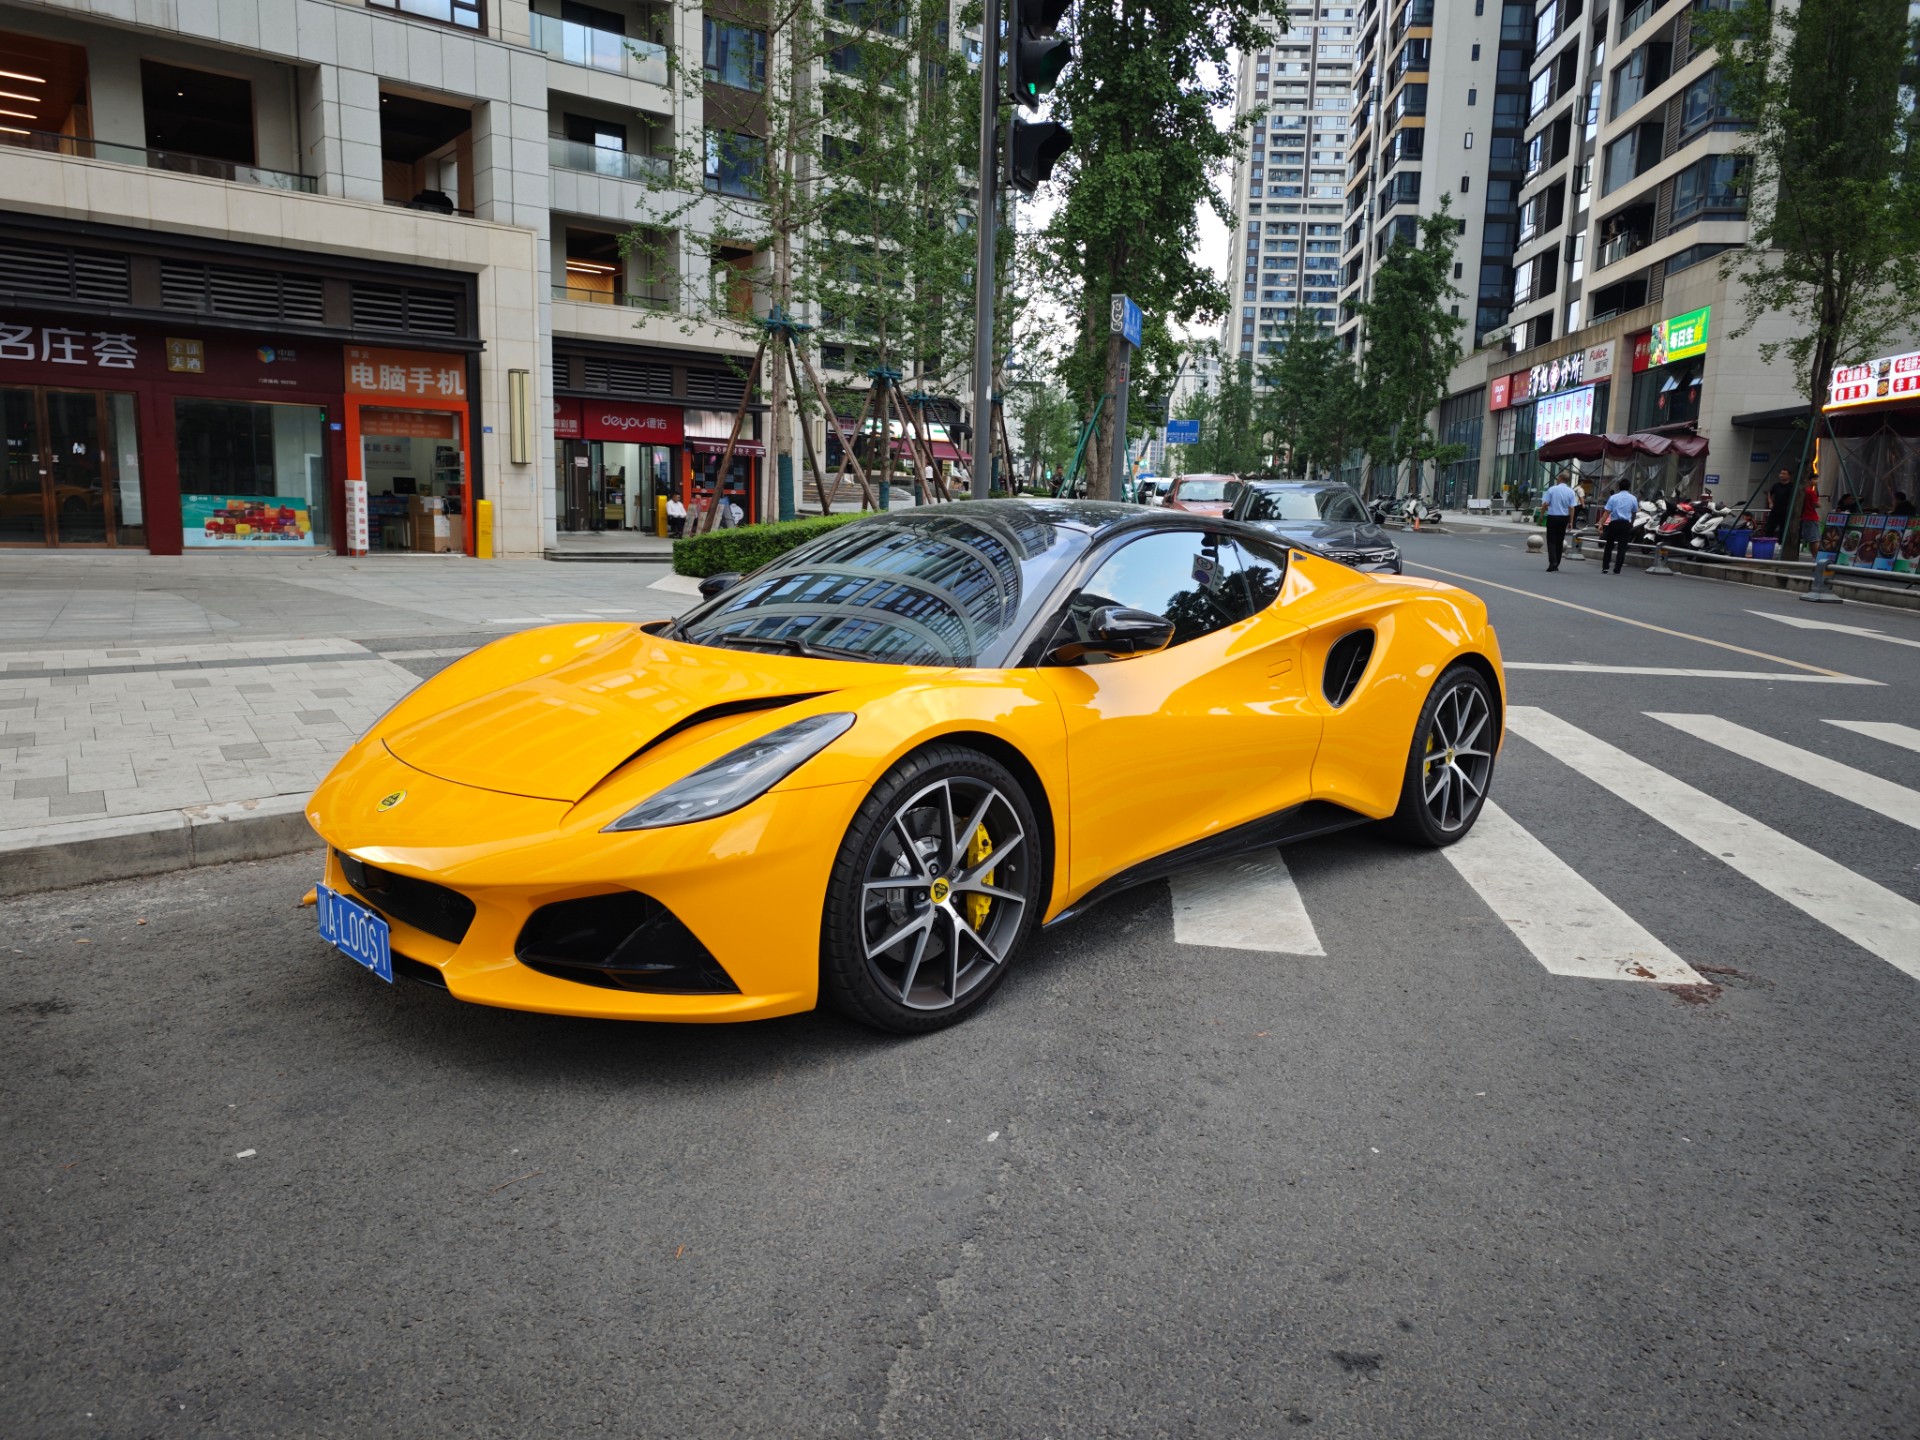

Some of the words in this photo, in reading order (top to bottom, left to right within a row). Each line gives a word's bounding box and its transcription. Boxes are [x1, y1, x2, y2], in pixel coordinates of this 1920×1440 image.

[0, 322, 138, 370] 名庄荟
[351, 362, 465, 395] 电脑手机
[601, 413, 646, 430] deyou
